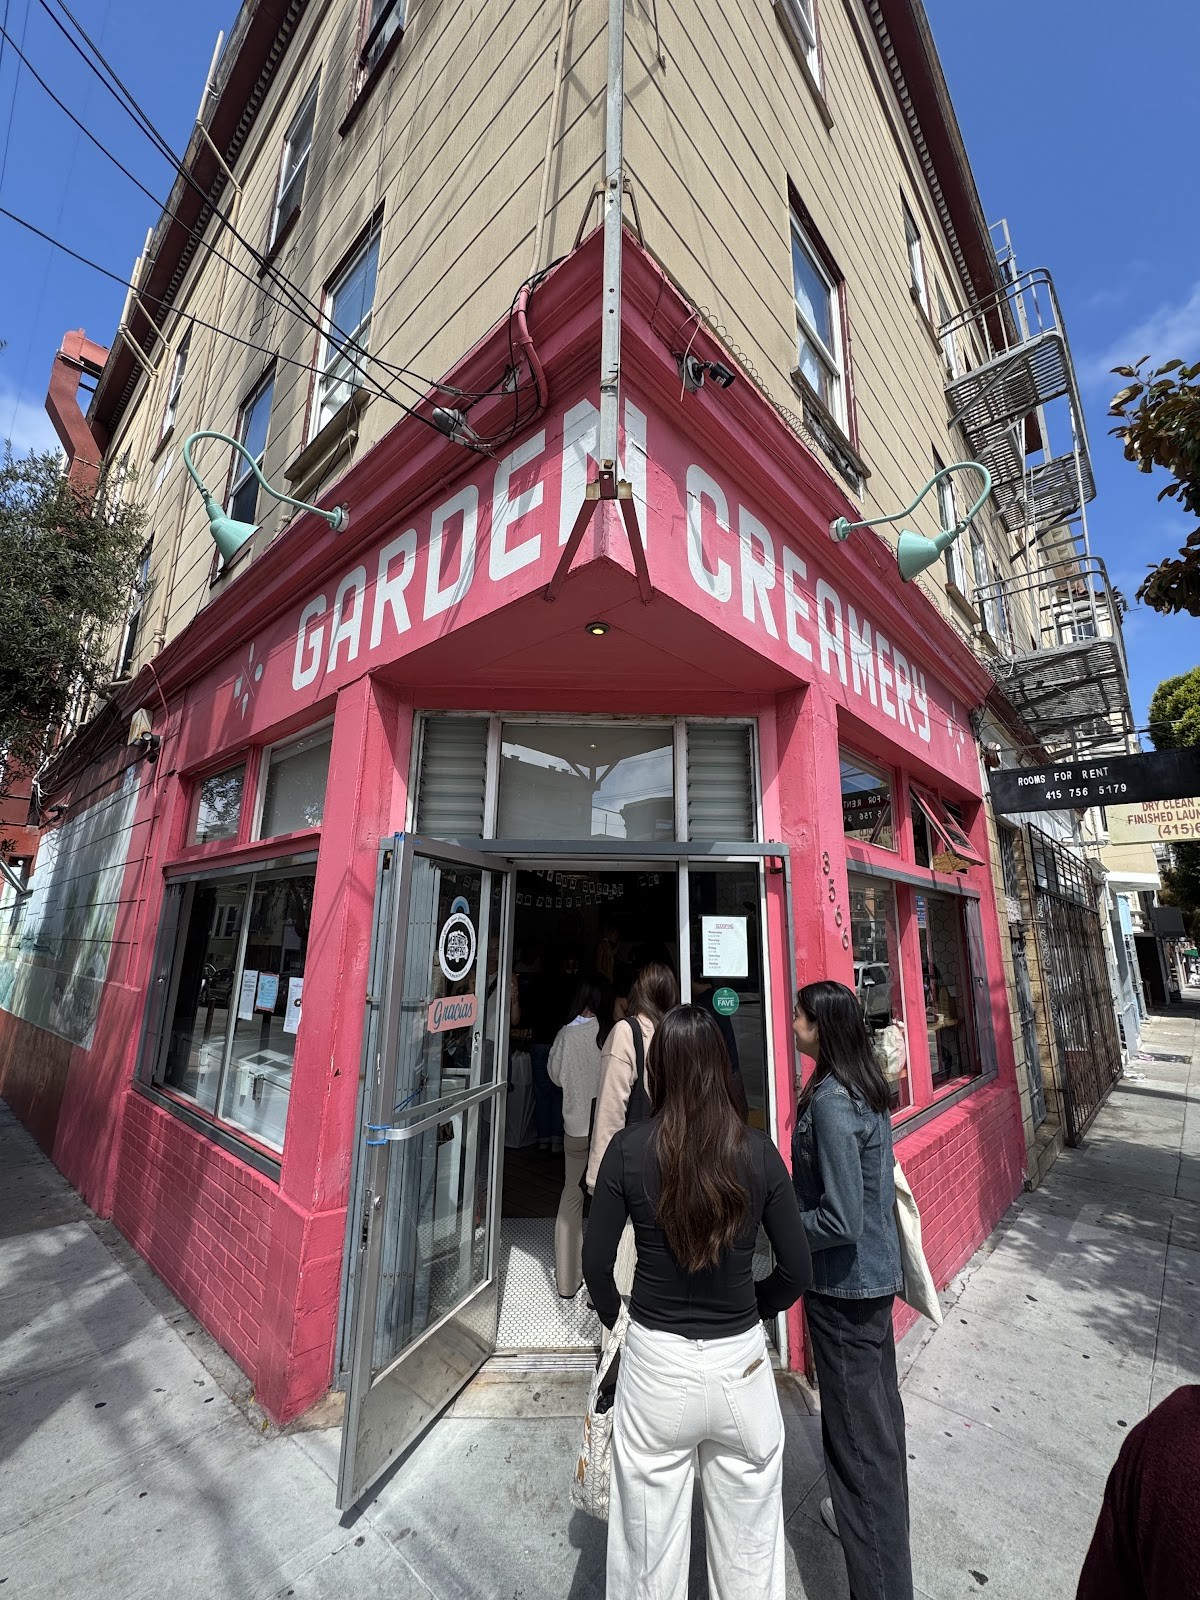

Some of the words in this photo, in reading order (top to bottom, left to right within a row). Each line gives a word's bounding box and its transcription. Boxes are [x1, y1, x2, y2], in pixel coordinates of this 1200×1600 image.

[292, 398, 647, 691] GARDEN
[686, 464, 931, 743] CREAMERY
[1018, 774, 1046, 786] ROOMS
[1054, 771, 1072, 782] FOR
[1082, 766, 1109, 779] RENT
[1046, 789, 1062, 800] 415
[1069, 787, 1088, 798] 756
[1099, 783, 1127, 795] 5179
[1142, 801, 1160, 812] DRY
[1163, 798, 1195, 810] CLEAN
[1127, 811, 1173, 825] FINISHED
[822, 851, 849, 951] 3566
[433, 997, 473, 1030] Gracias
